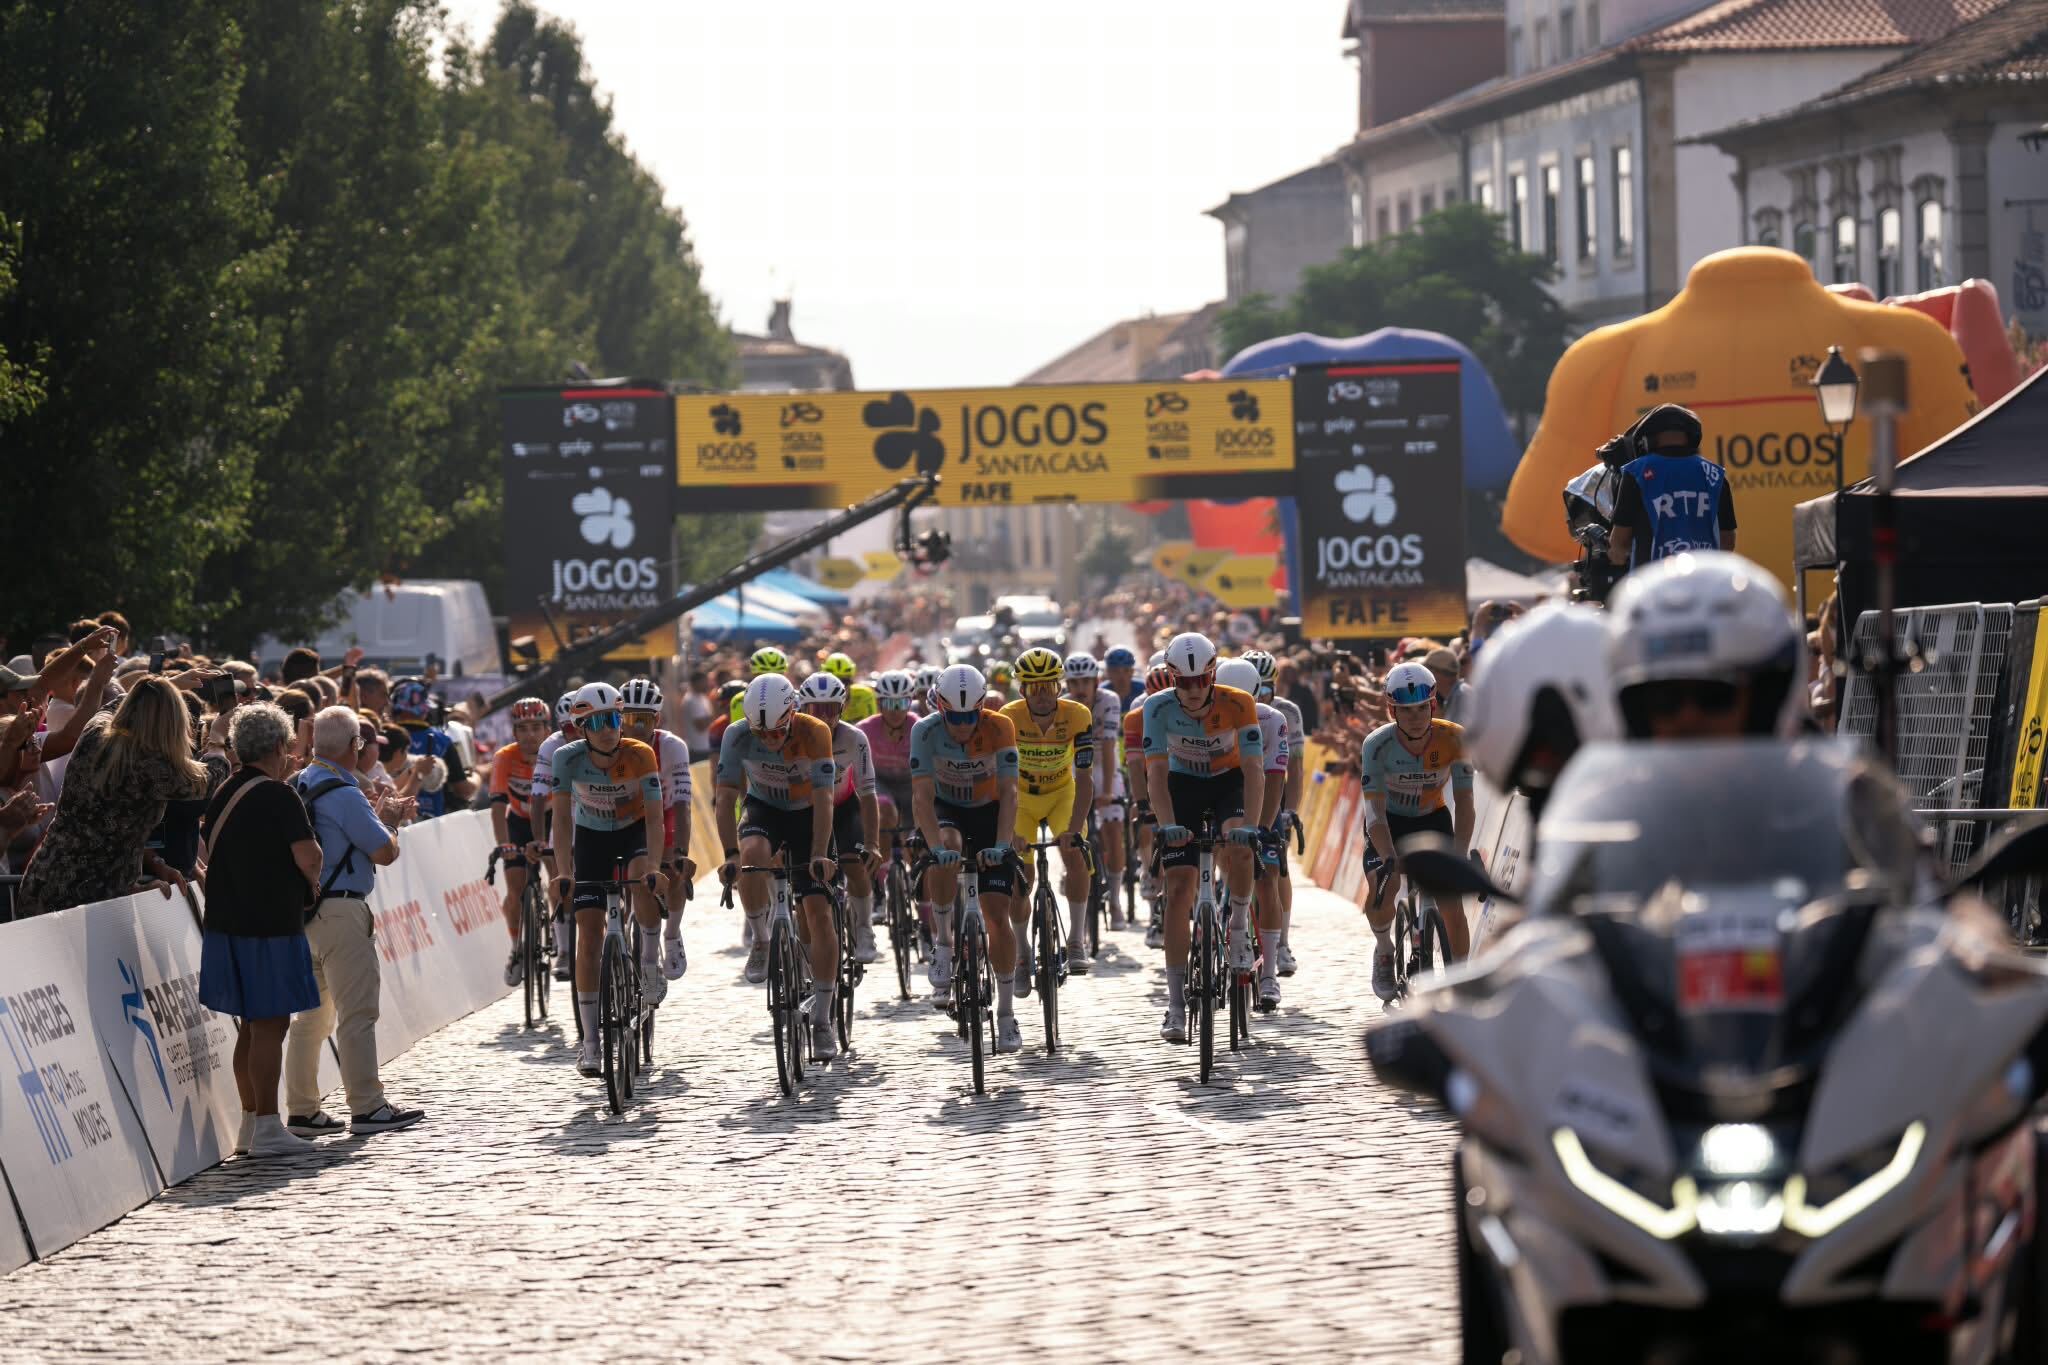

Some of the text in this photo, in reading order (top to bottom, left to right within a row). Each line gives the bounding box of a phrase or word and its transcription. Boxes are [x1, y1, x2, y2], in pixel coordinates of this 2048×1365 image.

[959, 401, 1108, 464] JOGOS
[1216, 427, 1274, 452] JOGOS
[1716, 432, 1835, 468] JOGOS
[975, 451, 1109, 475] SANTACASA
[961, 481, 1012, 501] FAFE
[1317, 534, 1424, 580] JOGOS
[551, 557, 658, 602] JOGOS
[1329, 599, 1409, 625] FAFE
[8, 983, 76, 1048] PAREDES
[40, 1061, 73, 1110] ROTA
